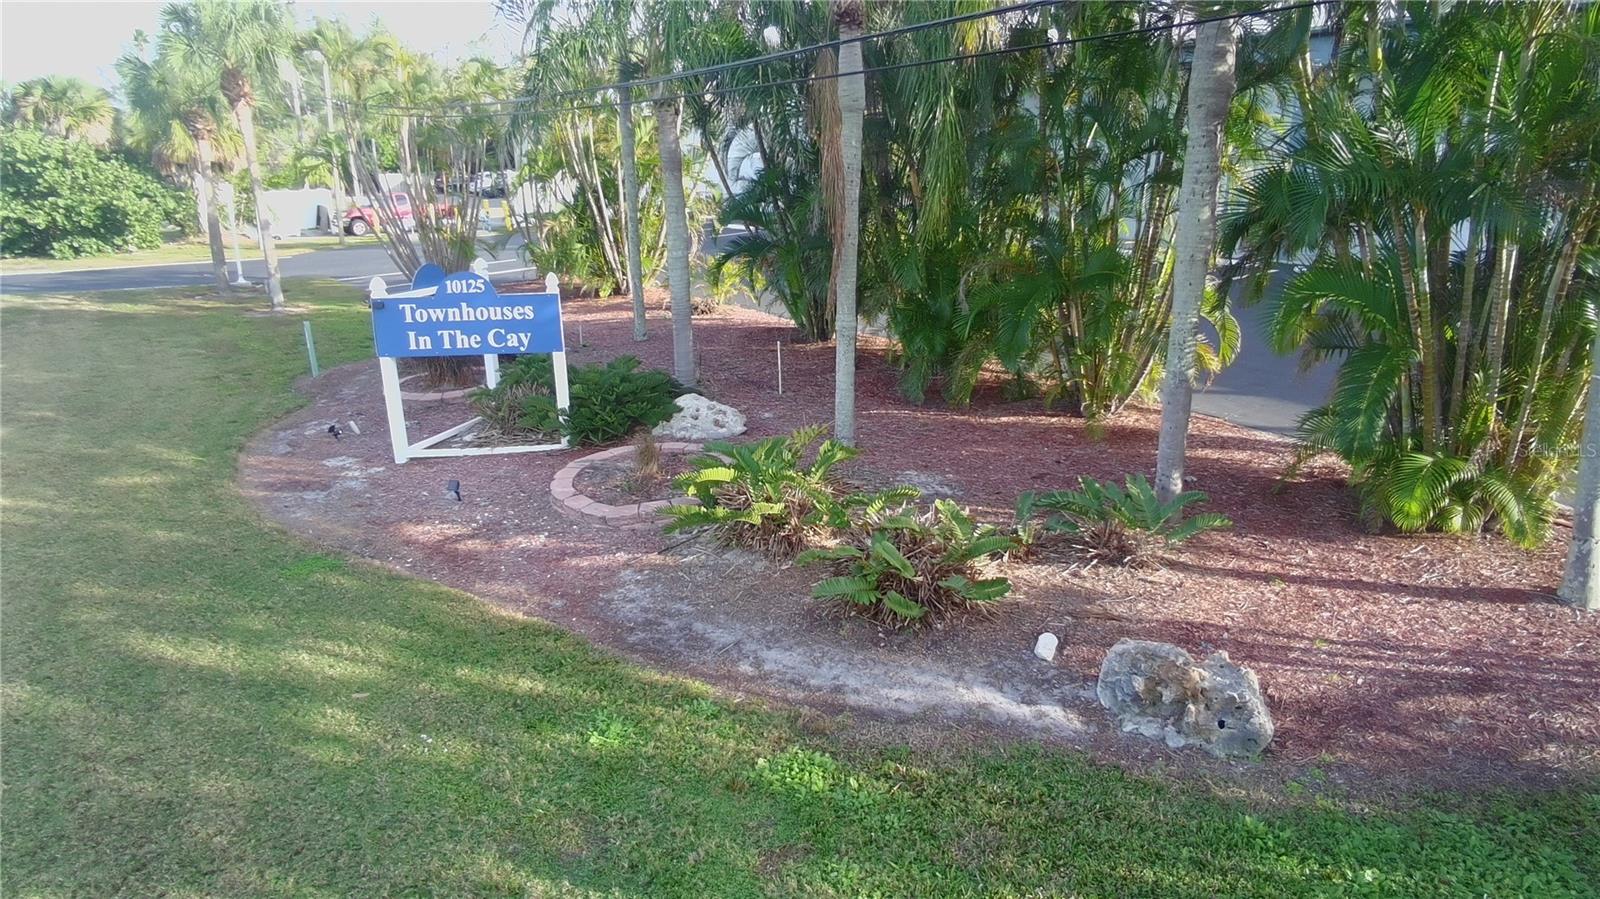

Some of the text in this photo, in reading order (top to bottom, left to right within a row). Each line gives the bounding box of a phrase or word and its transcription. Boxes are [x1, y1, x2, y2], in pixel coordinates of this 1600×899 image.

[445, 279, 485, 294] 10125
[399, 302, 535, 323] Townhouses
[408, 328, 532, 351] In The Cay
